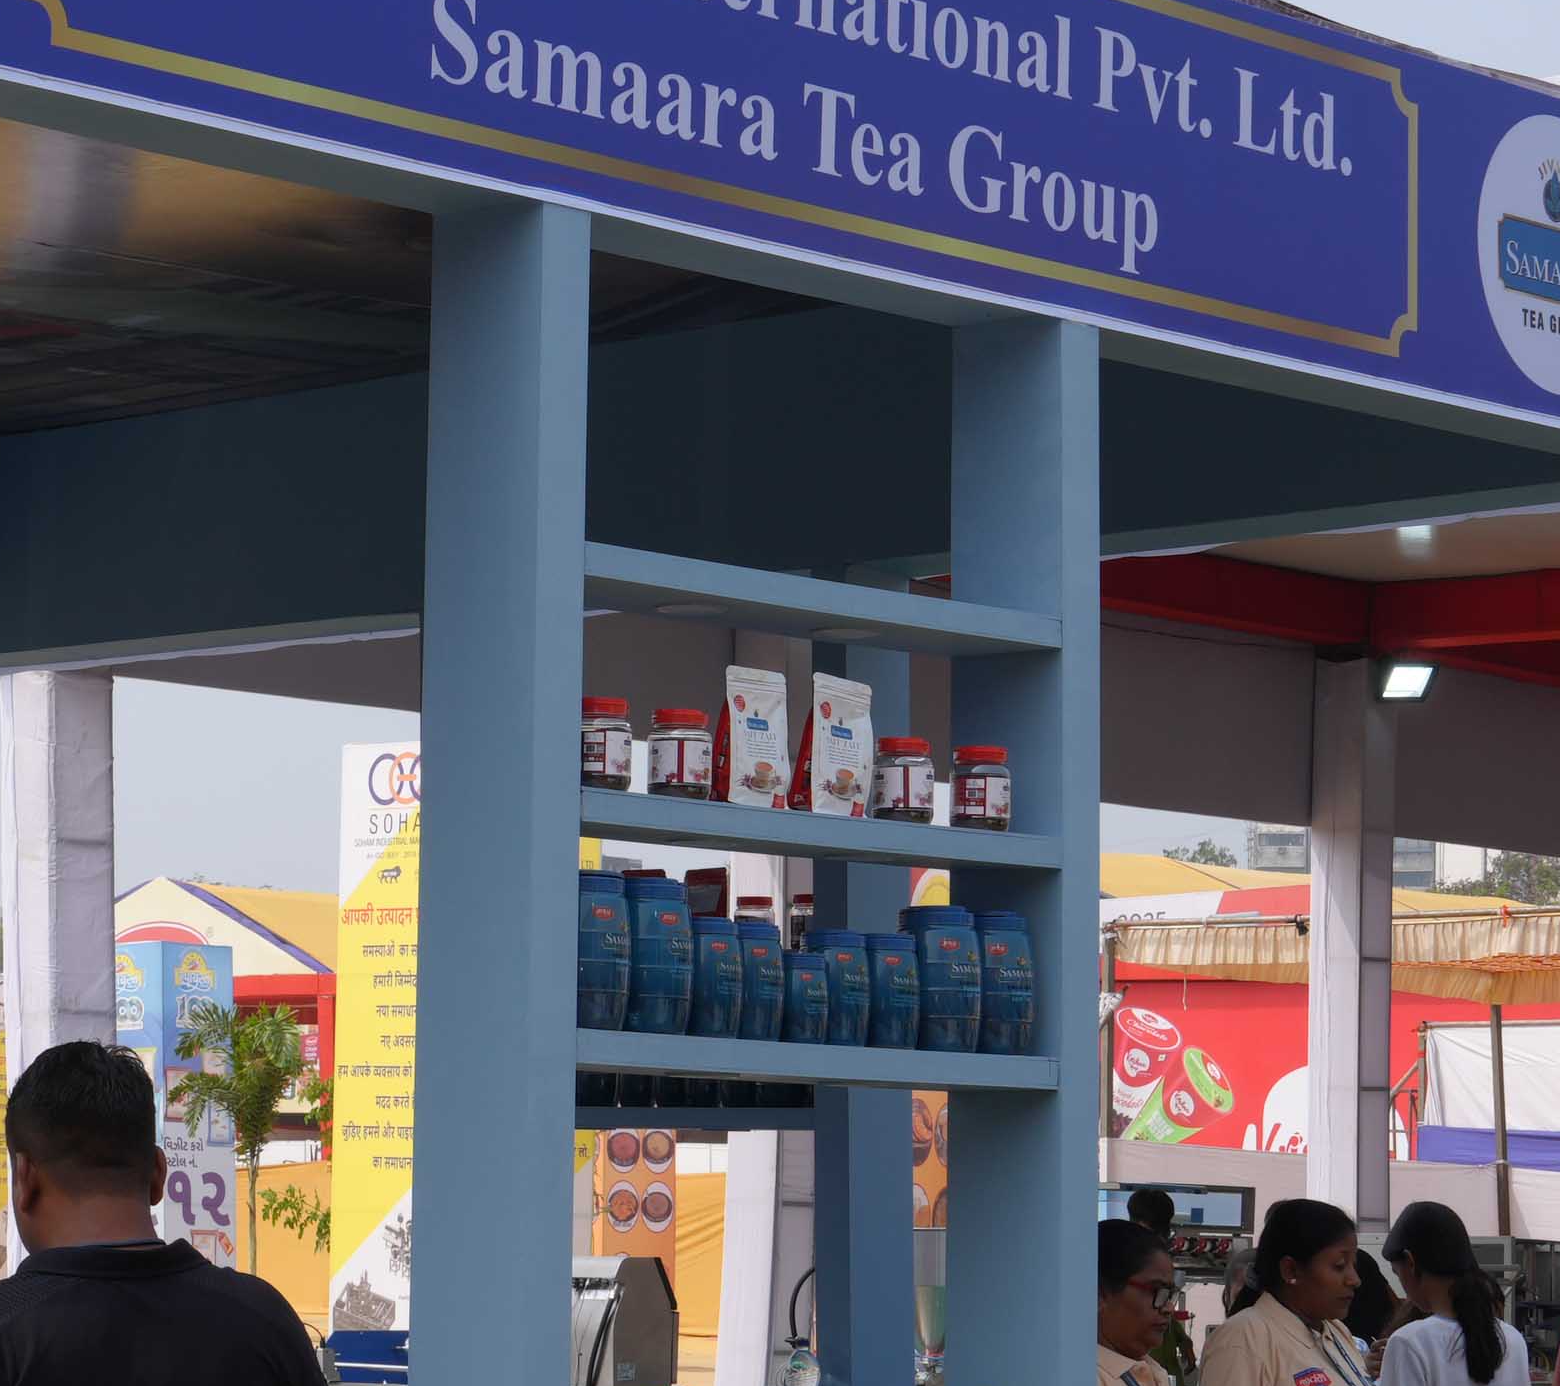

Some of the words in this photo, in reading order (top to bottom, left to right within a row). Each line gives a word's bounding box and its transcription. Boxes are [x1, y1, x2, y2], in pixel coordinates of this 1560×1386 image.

[1092, 25, 1213, 139] Pvt.
[1233, 67, 1353, 177] Ltd.
[803, 81, 924, 197] Tea
[948, 124, 1159, 275] Group
[1522, 307, 1545, 330] TEA
[368, 813, 421, 835] SOHA
[341, 901, 373, 926] आपकी
[376, 906, 413, 926] उत्पादन
[373, 970, 393, 989] हमारी
[350, 1060, 372, 1078] आपके
